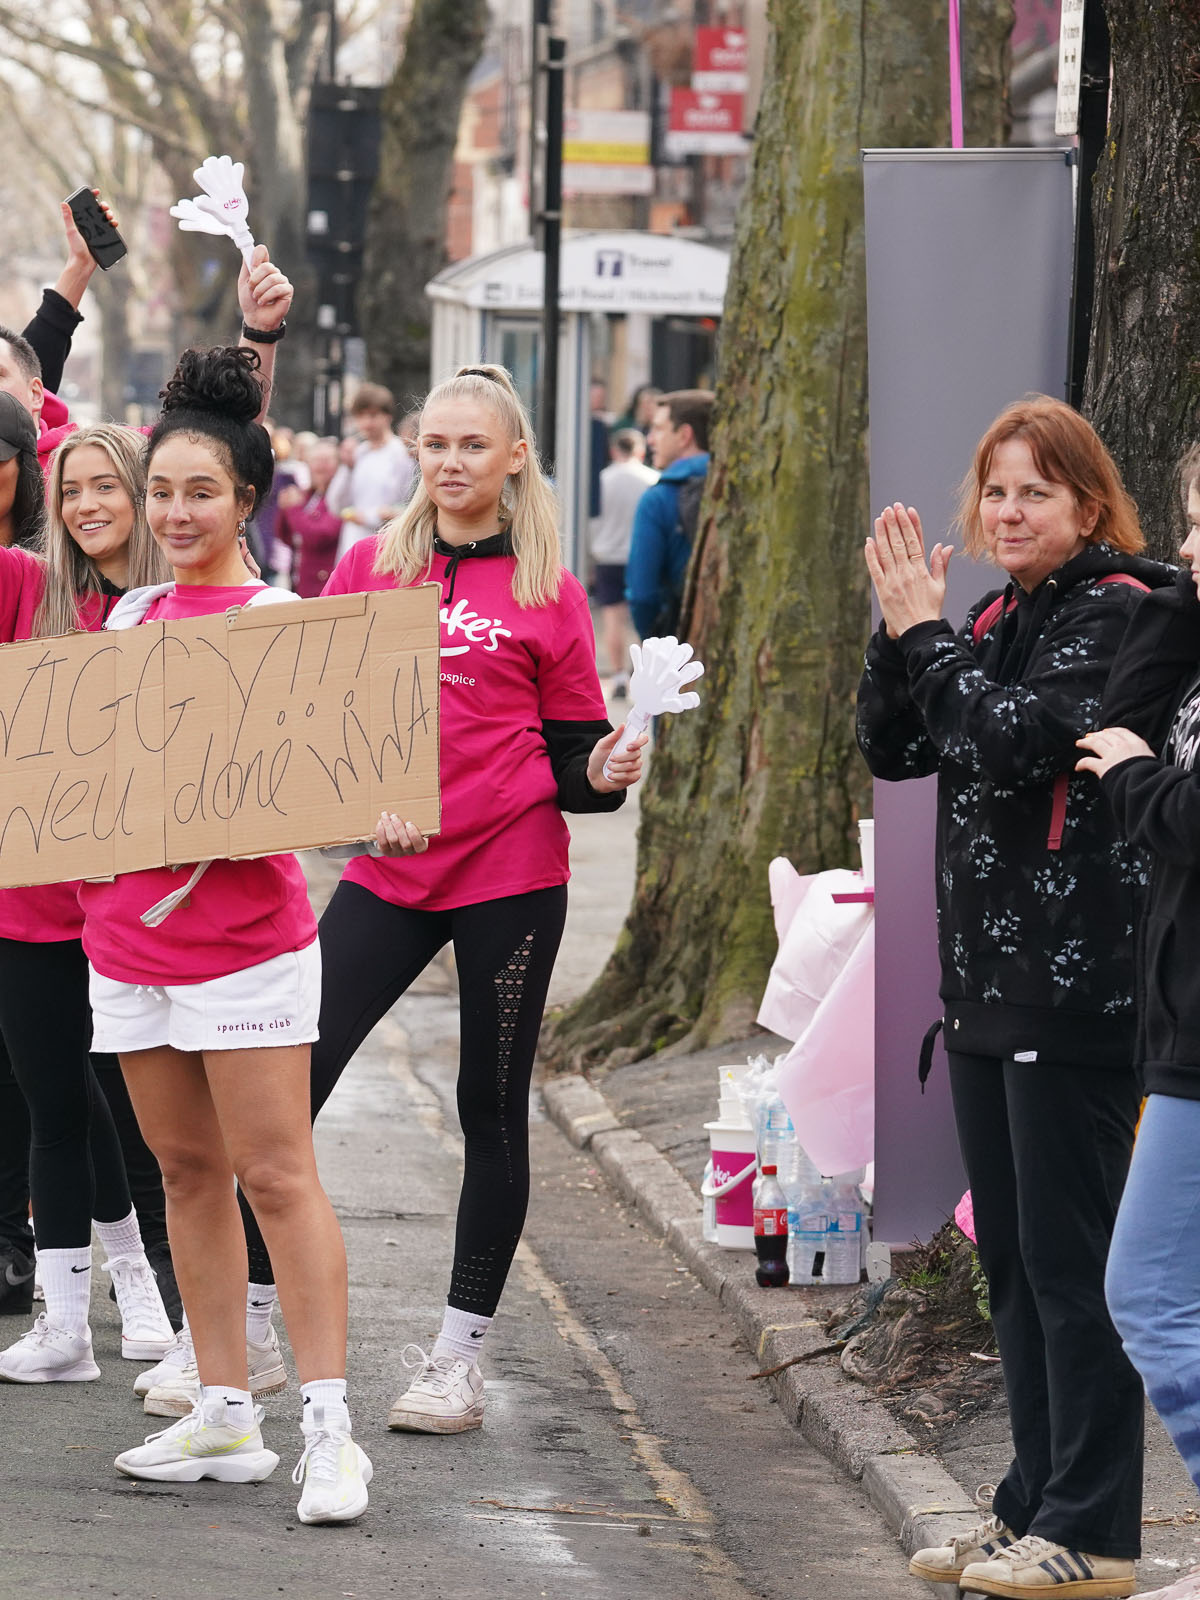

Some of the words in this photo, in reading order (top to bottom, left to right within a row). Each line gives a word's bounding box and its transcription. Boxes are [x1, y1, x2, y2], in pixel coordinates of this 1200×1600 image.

[440, 599, 512, 652] ke's
[440, 672, 476, 687] ospice
[174, 733, 292, 824] done
[217, 1022, 264, 1034] sporting
[269, 1018, 291, 1030] club
